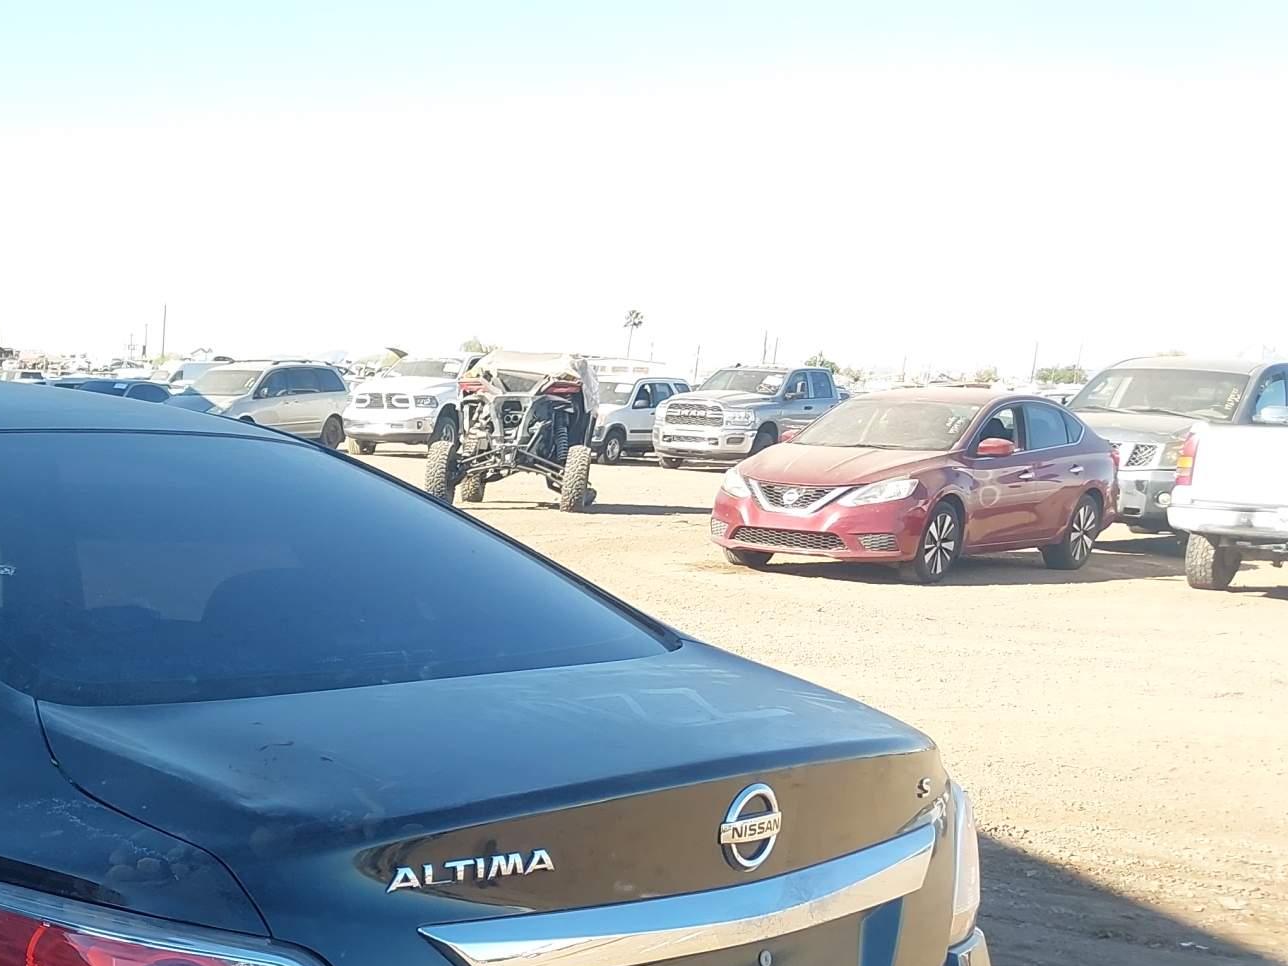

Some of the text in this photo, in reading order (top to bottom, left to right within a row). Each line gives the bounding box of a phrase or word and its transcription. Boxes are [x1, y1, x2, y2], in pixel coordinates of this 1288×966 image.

[917, 778, 931, 799] S
[731, 817, 780, 839] NISSAN
[386, 849, 555, 893] ALTIMA
